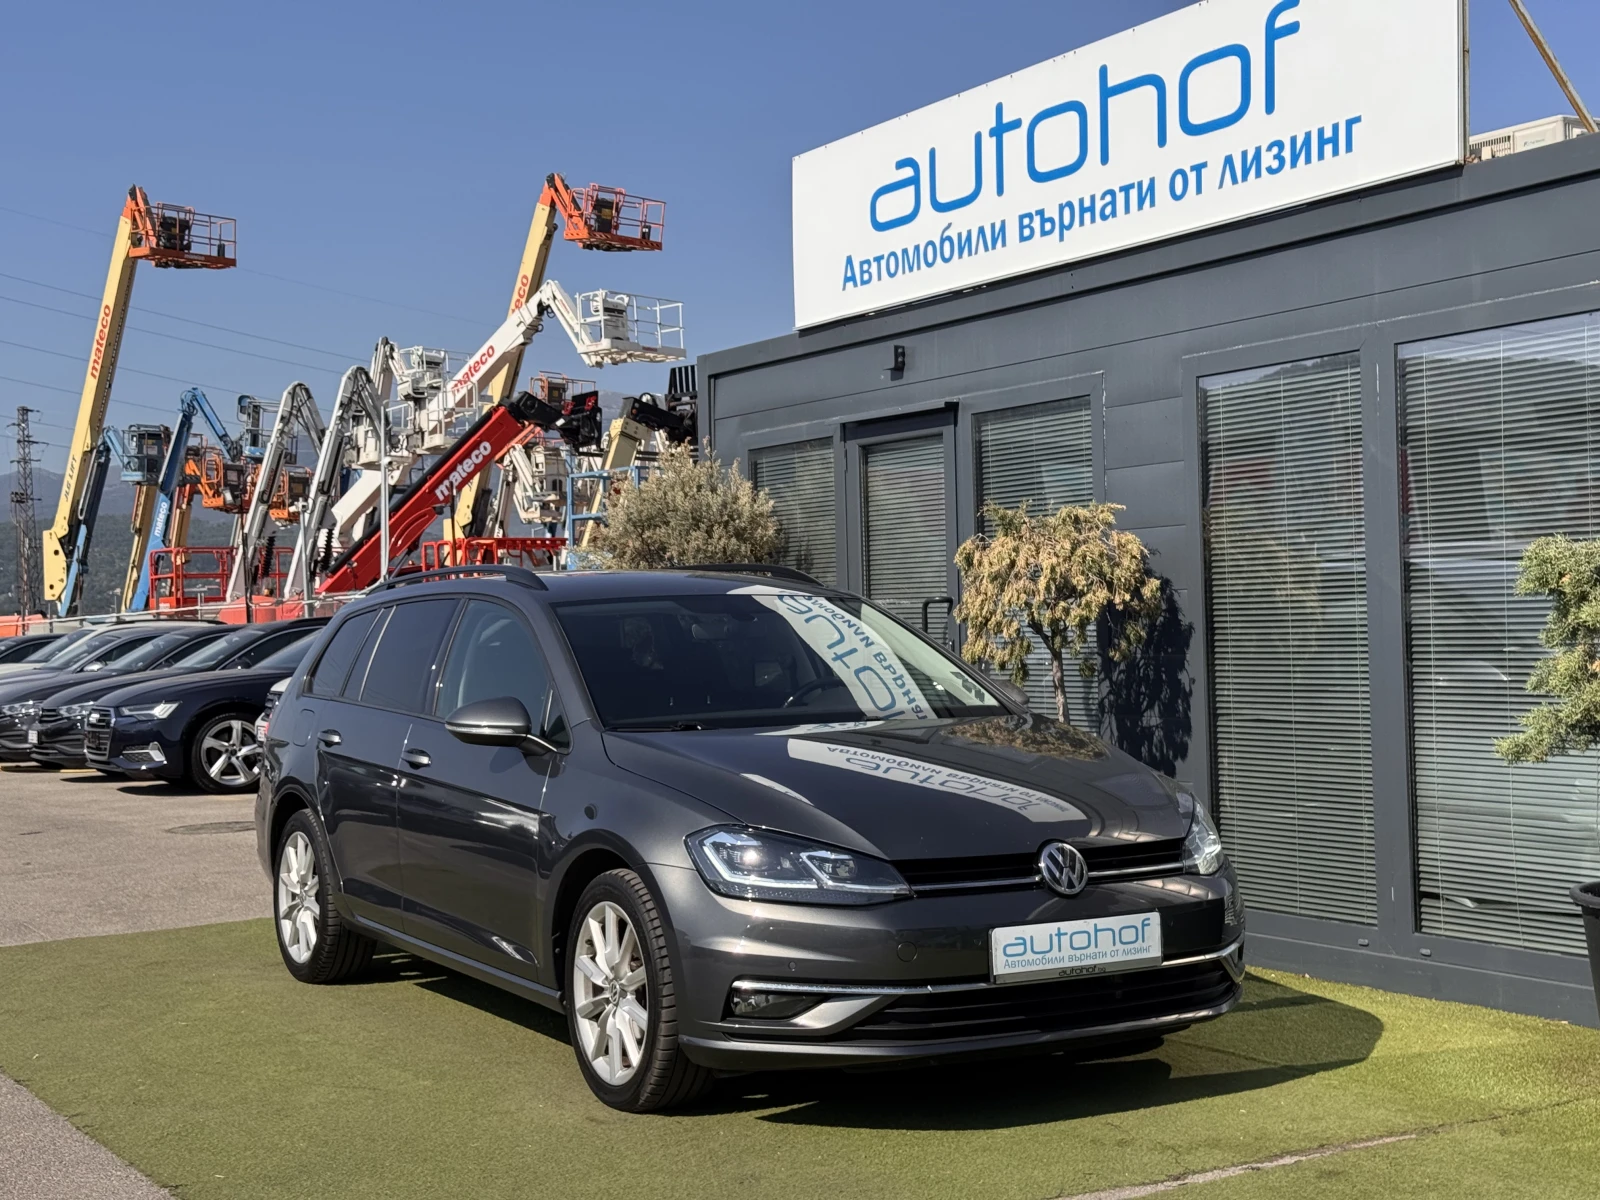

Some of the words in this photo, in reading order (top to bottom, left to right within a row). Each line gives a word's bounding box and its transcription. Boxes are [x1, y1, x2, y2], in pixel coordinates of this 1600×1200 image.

[870, 0, 1301, 233] autohof
[842, 222, 1006, 291] Автомобили
[1018, 175, 1157, 244] върнати
[1169, 160, 1208, 202] от
[1219, 114, 1363, 189] лизинг
[90, 304, 111, 380] mateco
[68, 454, 77, 480] LIFT
[434, 441, 492, 502] mateco
[154, 501, 168, 538] mateco
[1002, 917, 1151, 958] autohof
[1003, 954, 1065, 970] Автомобили
[1067, 950, 1108, 963] върнати
[1110, 948, 1120, 958] от
[1121, 944, 1153, 957] лизинг
